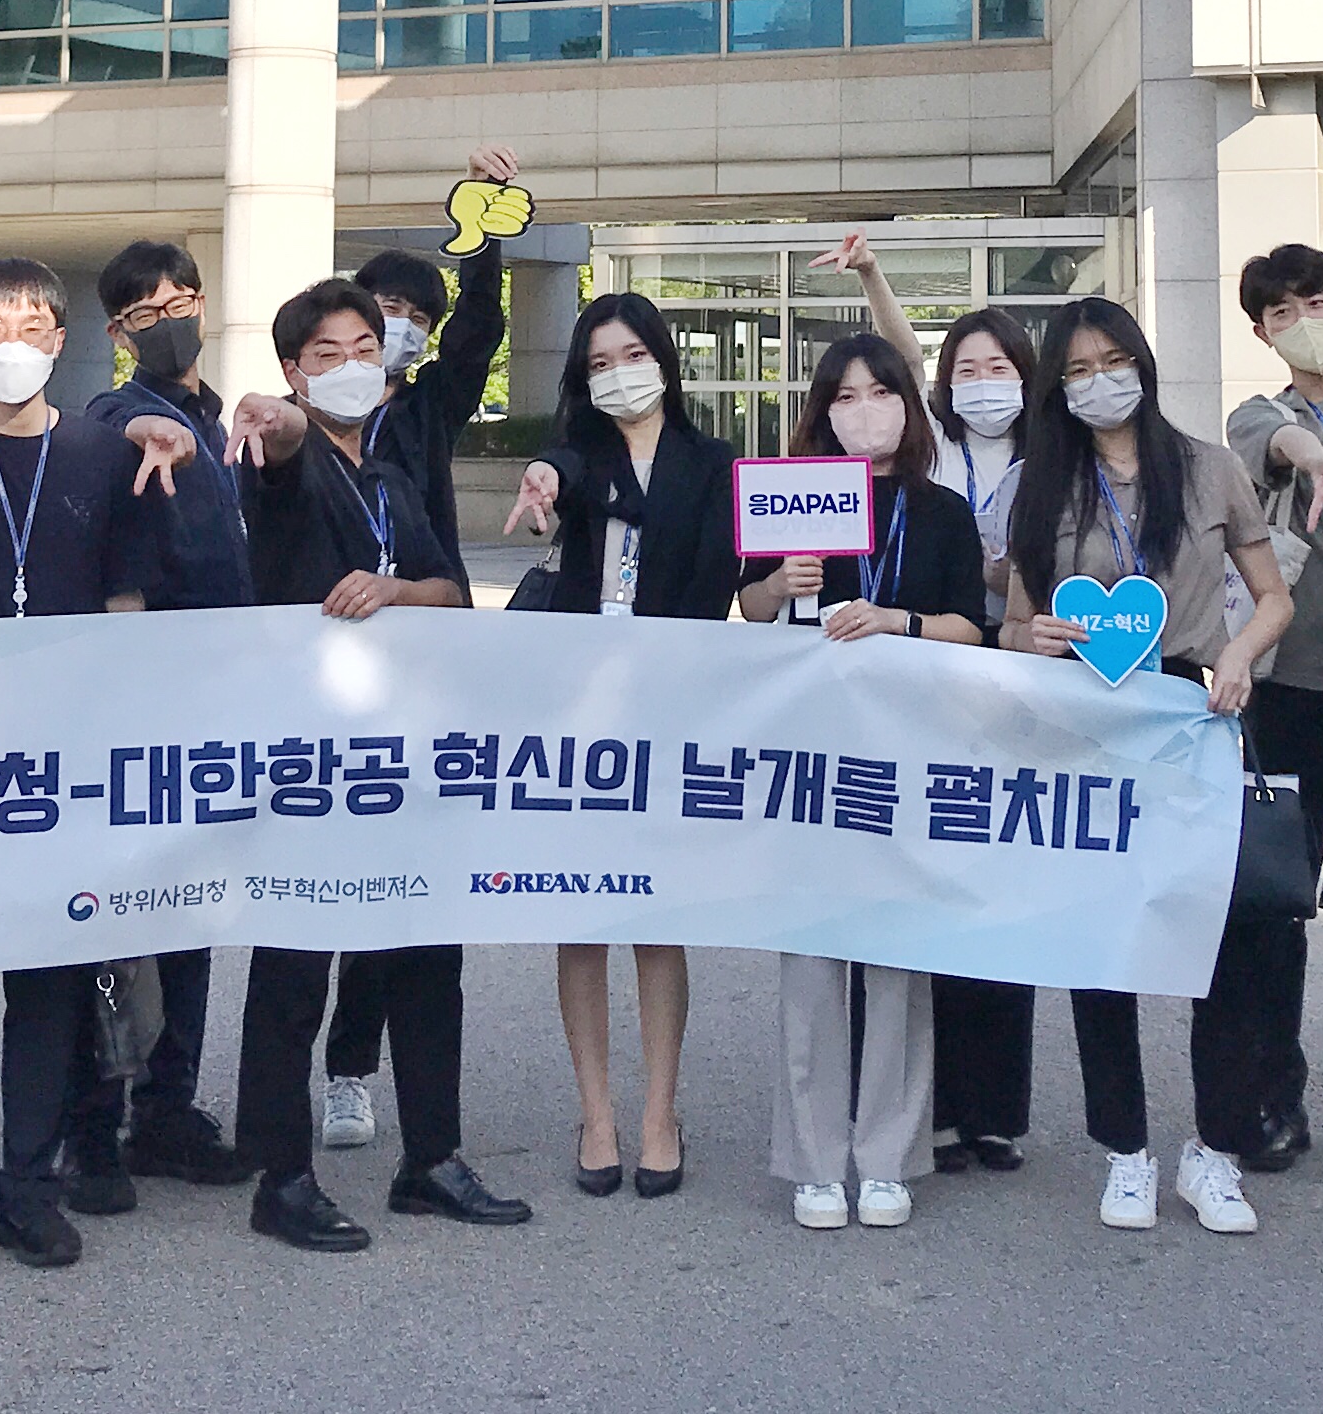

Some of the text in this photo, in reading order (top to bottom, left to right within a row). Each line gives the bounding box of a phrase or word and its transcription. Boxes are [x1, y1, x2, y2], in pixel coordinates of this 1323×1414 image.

[748, 492, 860, 516] 응DAPA라
[432, 731, 652, 813] 혁신의
[680, 739, 898, 837] 날개를
[924, 760, 1140, 853] 펼치다
[108, 874, 429, 916] 방위사업청 정부혁신어벤져스
[469, 871, 655, 895] KOREAN AIR
